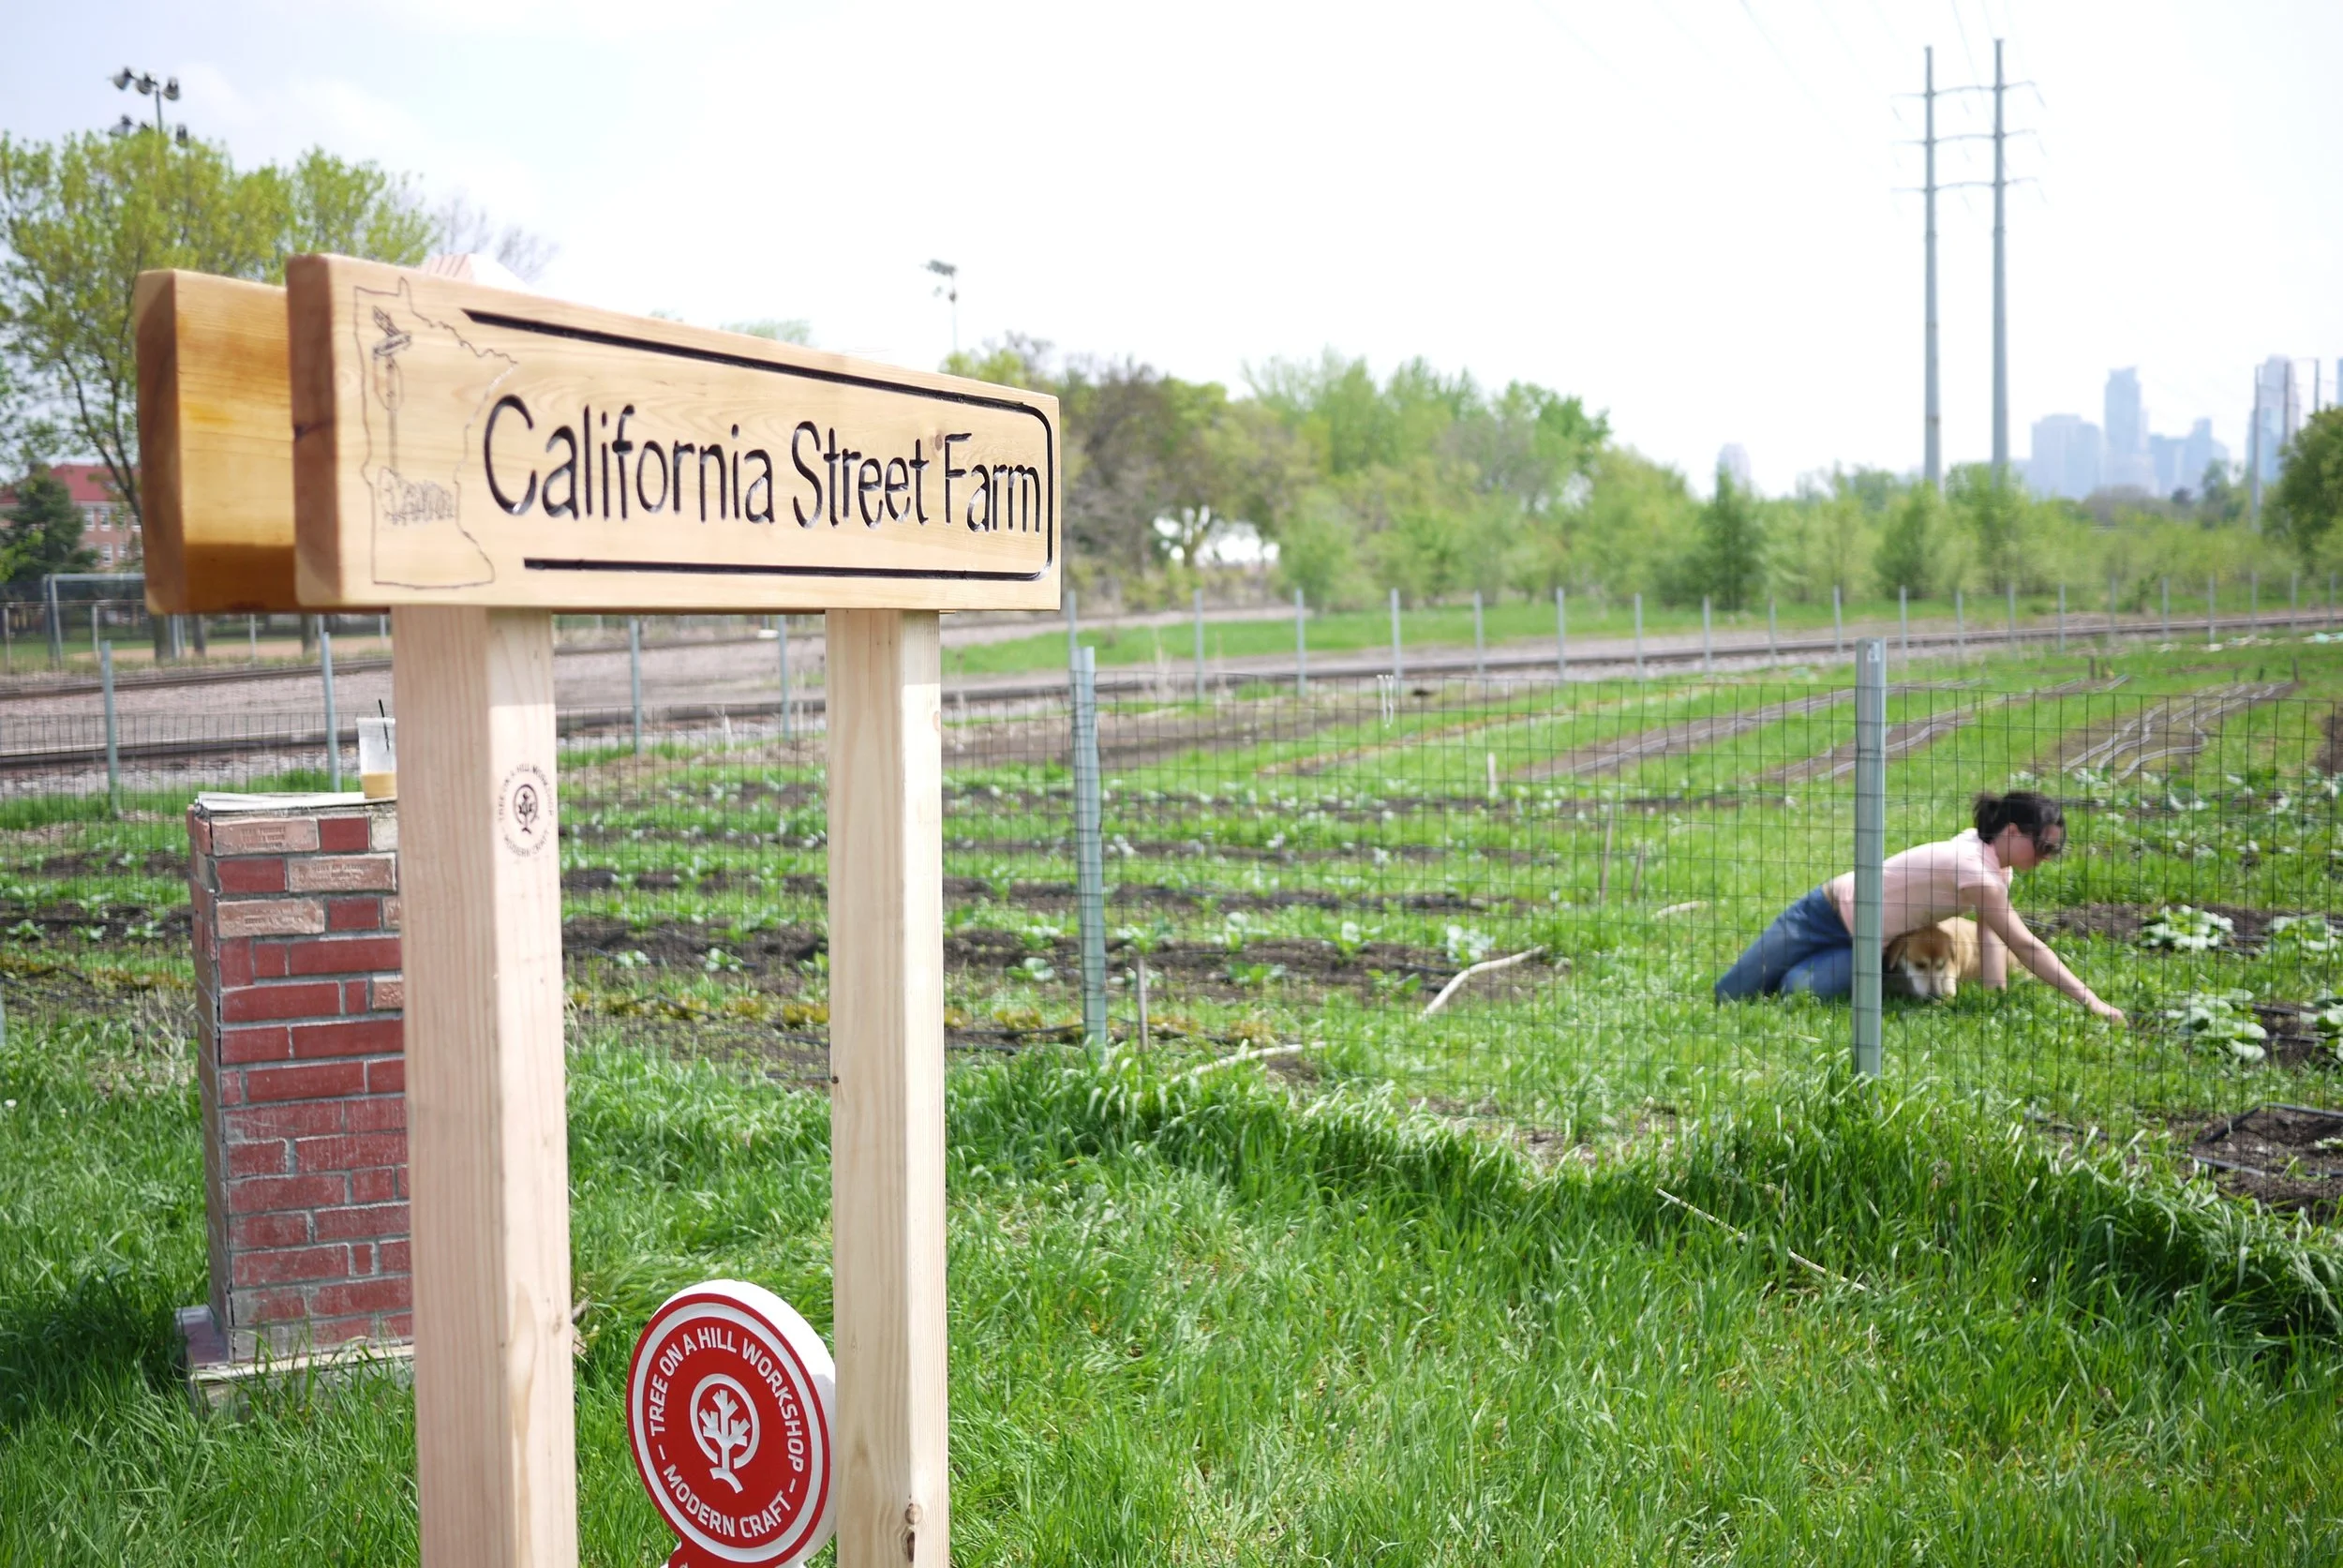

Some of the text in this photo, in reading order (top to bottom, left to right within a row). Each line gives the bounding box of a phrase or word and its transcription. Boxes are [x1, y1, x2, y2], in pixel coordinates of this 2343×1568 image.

[484, 394, 1042, 534] California Street Farm
[649, 1326, 804, 1473] TREE ON A HILL WORKSHOP
[663, 1463, 791, 1539] MODERN CRAFT
